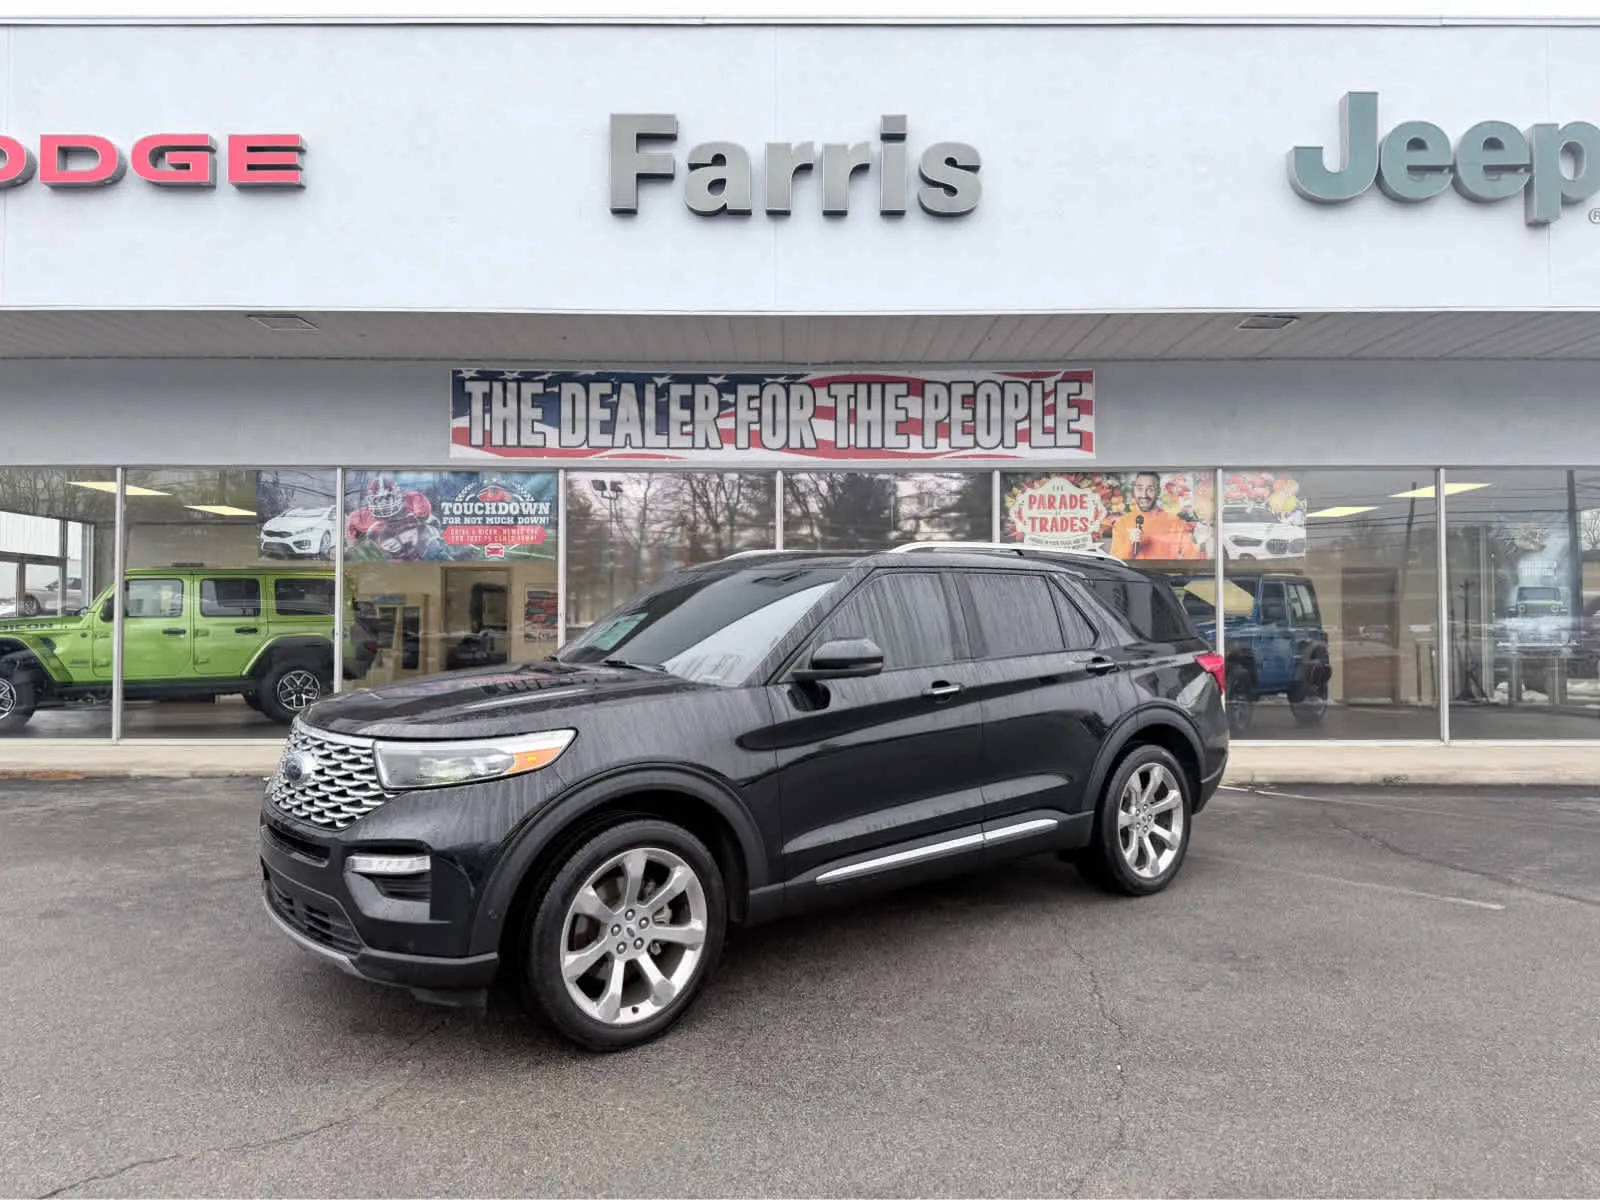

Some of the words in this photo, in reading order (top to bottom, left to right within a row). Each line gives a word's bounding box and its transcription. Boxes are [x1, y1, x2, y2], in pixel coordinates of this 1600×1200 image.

[609, 112, 983, 217] Farris
[1287, 91, 1600, 228] Jeep
[464, 381, 547, 448] THE
[559, 381, 723, 449] DEALER
[735, 381, 818, 450] FOR
[827, 380, 910, 449] THE
[921, 380, 1082, 449] PEOPLE
[441, 502, 551, 515] TOUCHDOWN
[1028, 494, 1089, 510] PARADE
[442, 516, 461, 524] FOR
[464, 516, 483, 524] NOT
[486, 516, 514, 524] MUCH
[518, 516, 549, 524] DOWN!
[1028, 517, 1089, 533] TRADES
